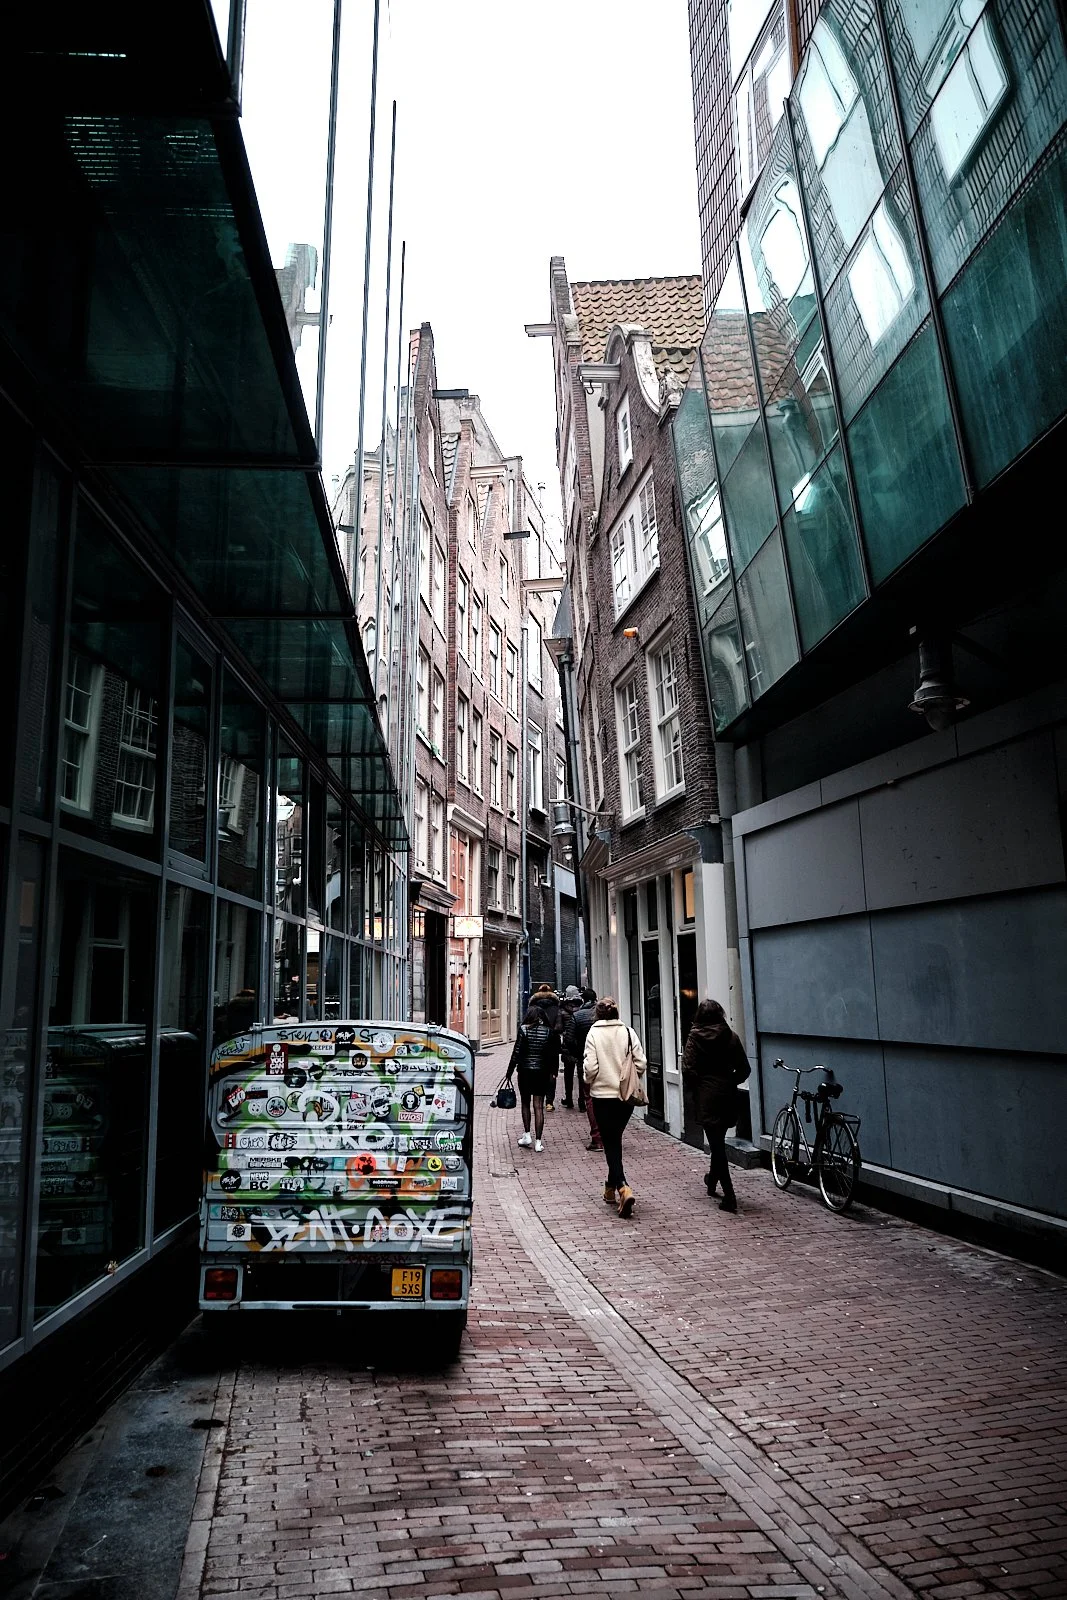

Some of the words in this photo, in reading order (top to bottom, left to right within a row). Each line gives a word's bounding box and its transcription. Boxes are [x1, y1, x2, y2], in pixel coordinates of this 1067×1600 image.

[250, 1172, 269, 1180] NEWS
[250, 1181, 269, 1190] BC
[402, 1271, 421, 1282] F19
[401, 1284, 420, 1294] 5XS
